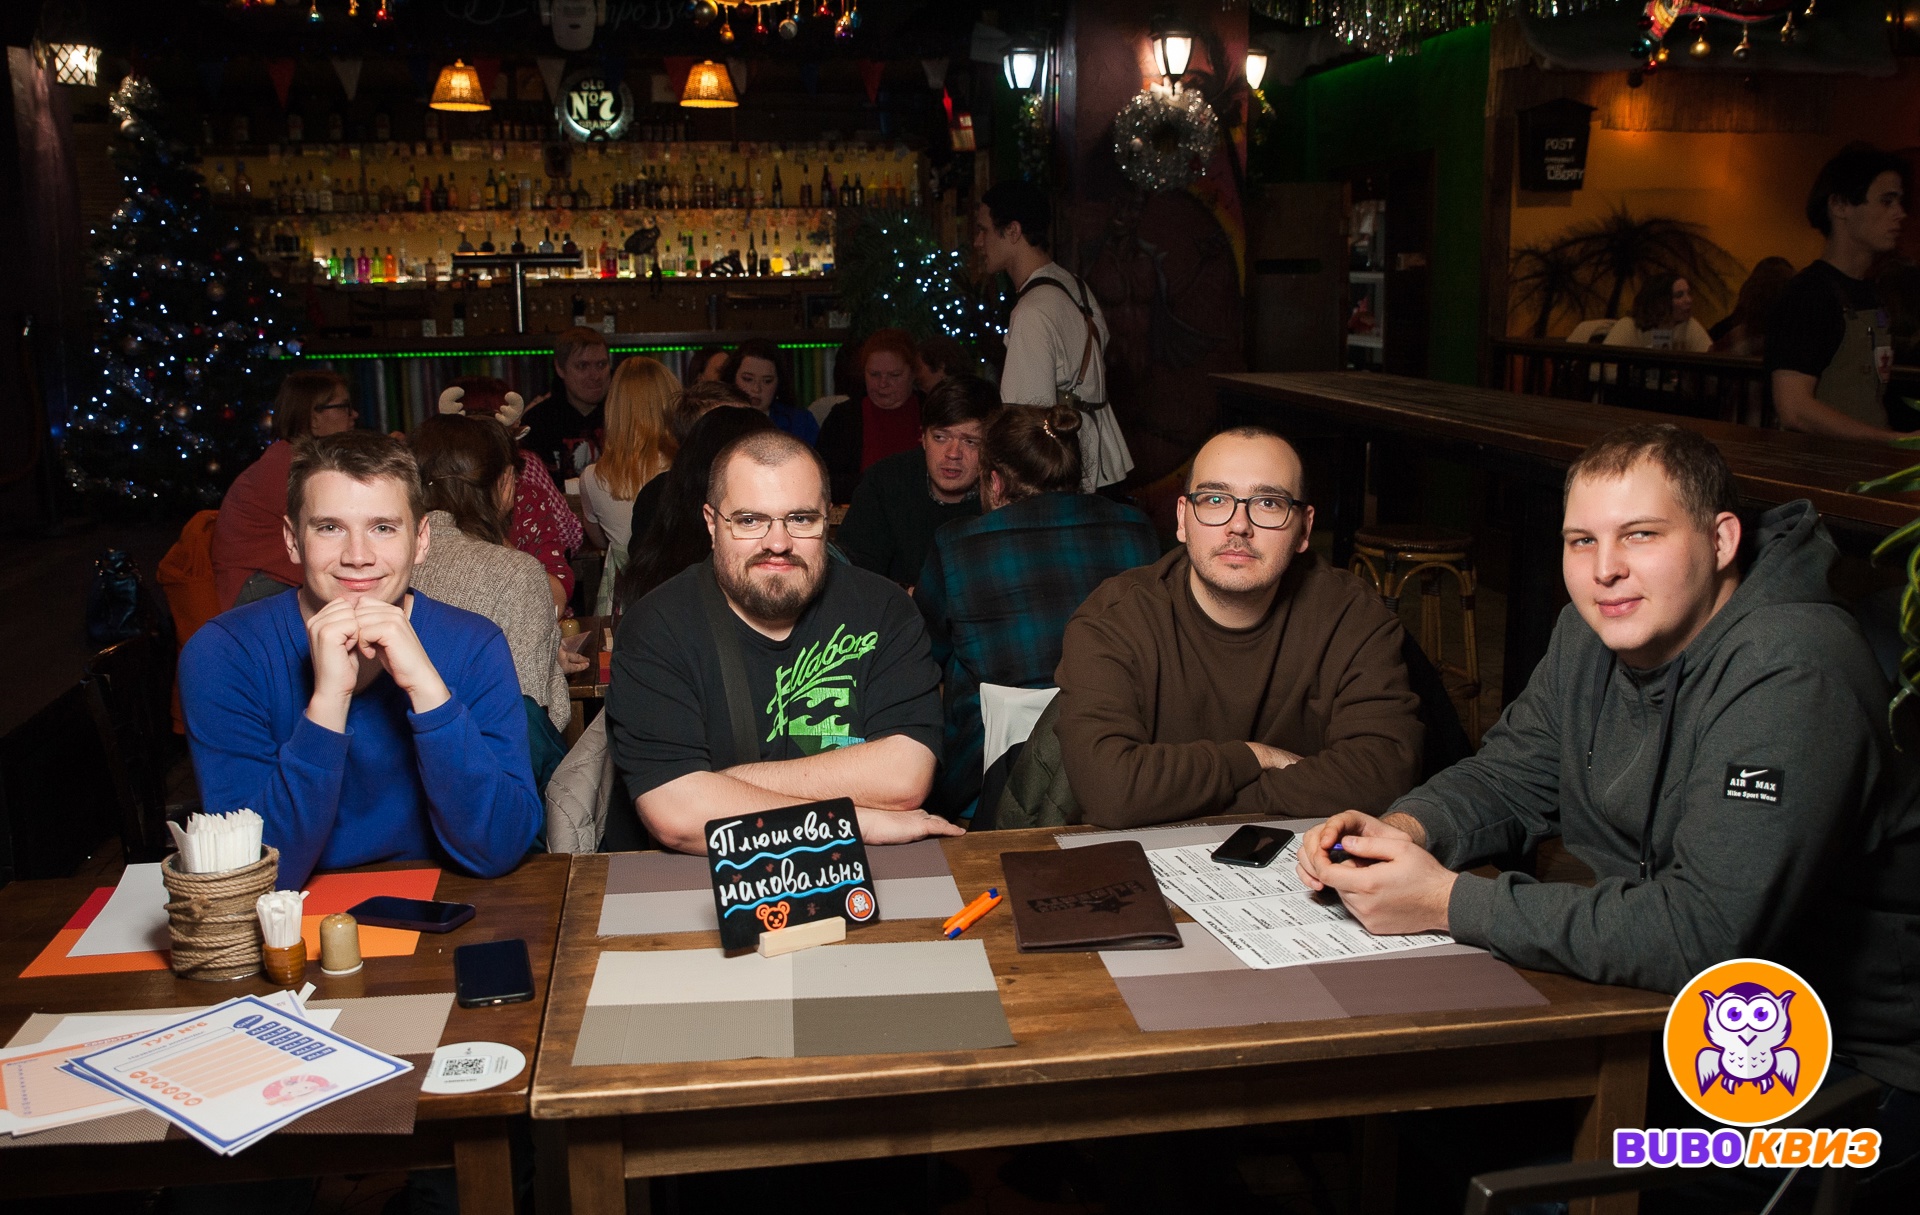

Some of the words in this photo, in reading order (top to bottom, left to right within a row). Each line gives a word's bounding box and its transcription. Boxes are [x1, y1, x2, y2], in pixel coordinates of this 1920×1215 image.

[581, 80, 604, 90] OLD
[1545, 138, 1575, 150] POST
[1547, 168, 1584, 180] LIBERTY
[1730, 778, 1746, 787] AIR
[1755, 781, 1776, 791] MAX
[1727, 789, 1741, 797] Nike
[1742, 791, 1759, 799] Sport
[1760, 793, 1777, 802] Wear
[709, 811, 854, 857] Плюшевая
[141, 1033, 175, 1047] ТУР
